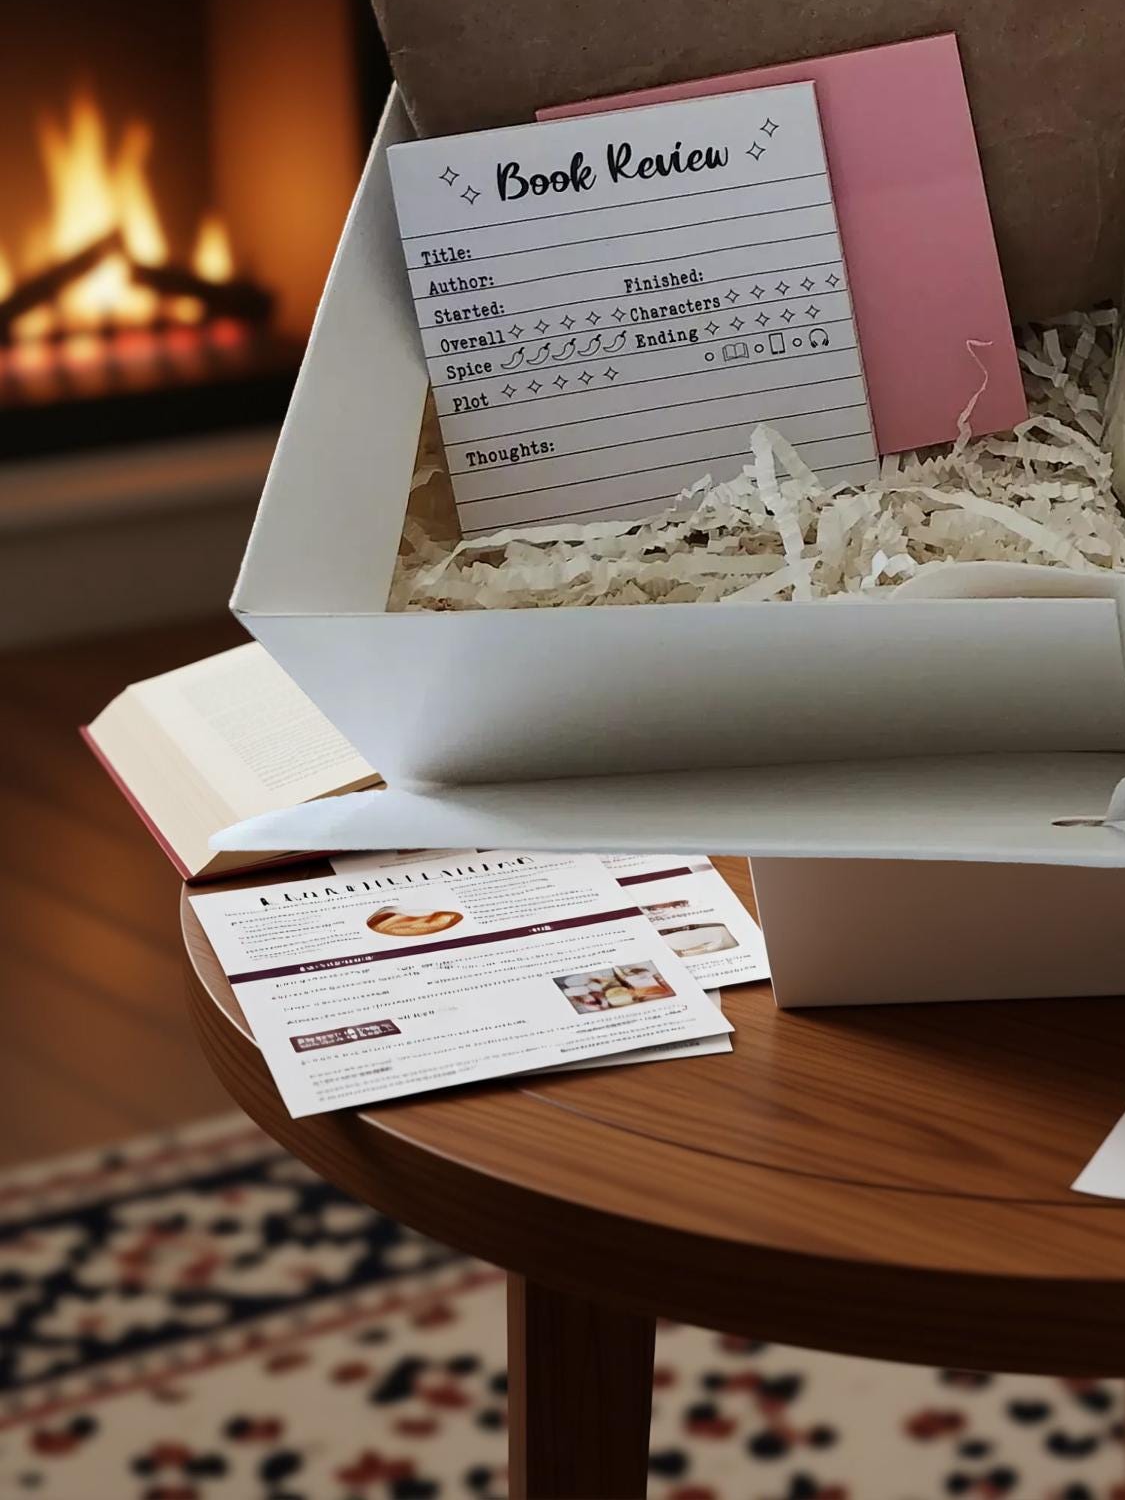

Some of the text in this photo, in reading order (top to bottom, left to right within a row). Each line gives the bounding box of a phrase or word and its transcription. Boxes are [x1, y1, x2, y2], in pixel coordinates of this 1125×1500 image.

[496, 141, 730, 201] Book Review
[421, 246, 472, 266] Title:
[428, 273, 495, 296] Author:
[434, 269, 704, 324] Started: Finished:
[440, 295, 721, 354] Overall Characters
[446, 326, 699, 381] Spice Ending
[452, 393, 490, 413] Plot
[465, 440, 556, 467] Thoughts:
